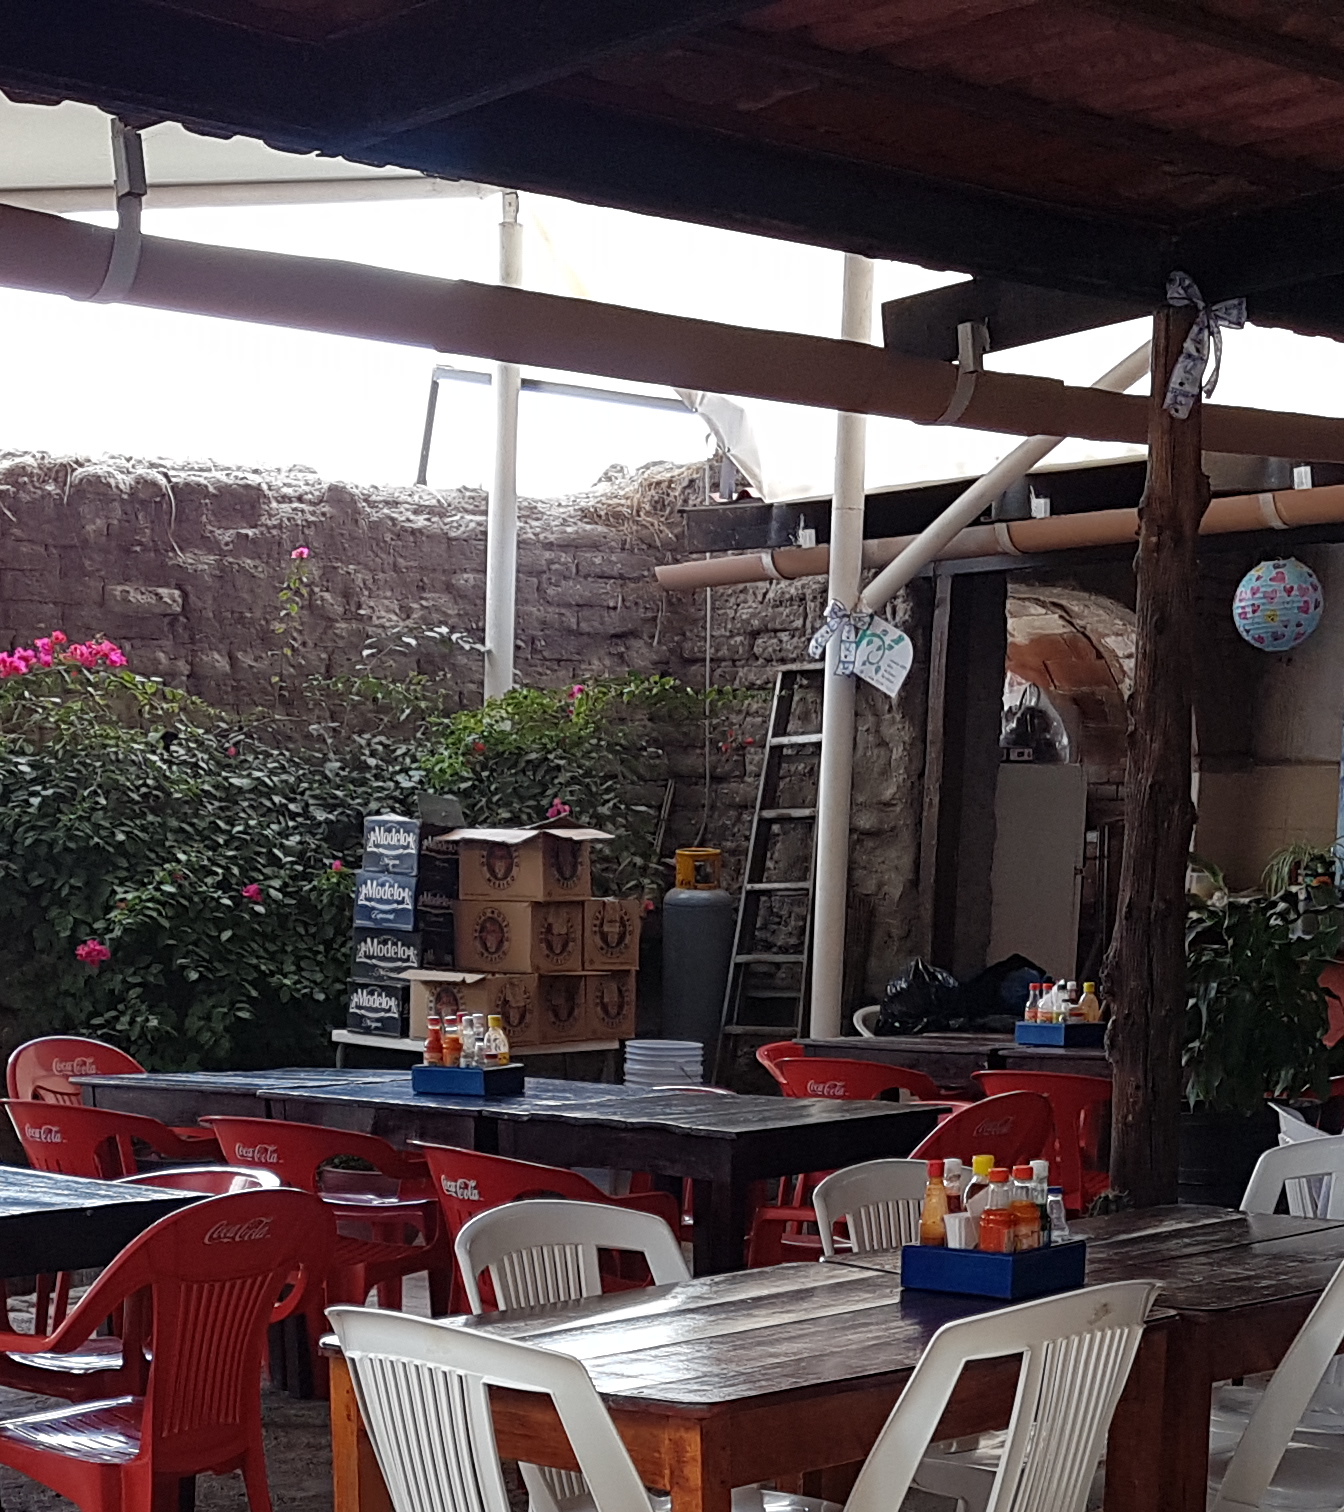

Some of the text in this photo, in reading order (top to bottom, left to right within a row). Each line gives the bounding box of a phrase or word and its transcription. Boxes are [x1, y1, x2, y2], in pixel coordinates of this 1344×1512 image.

[374, 825, 409, 846] Modelo
[366, 879, 407, 901] Modelo
[366, 936, 409, 959] Modelo
[357, 987, 390, 1010] Modelo
